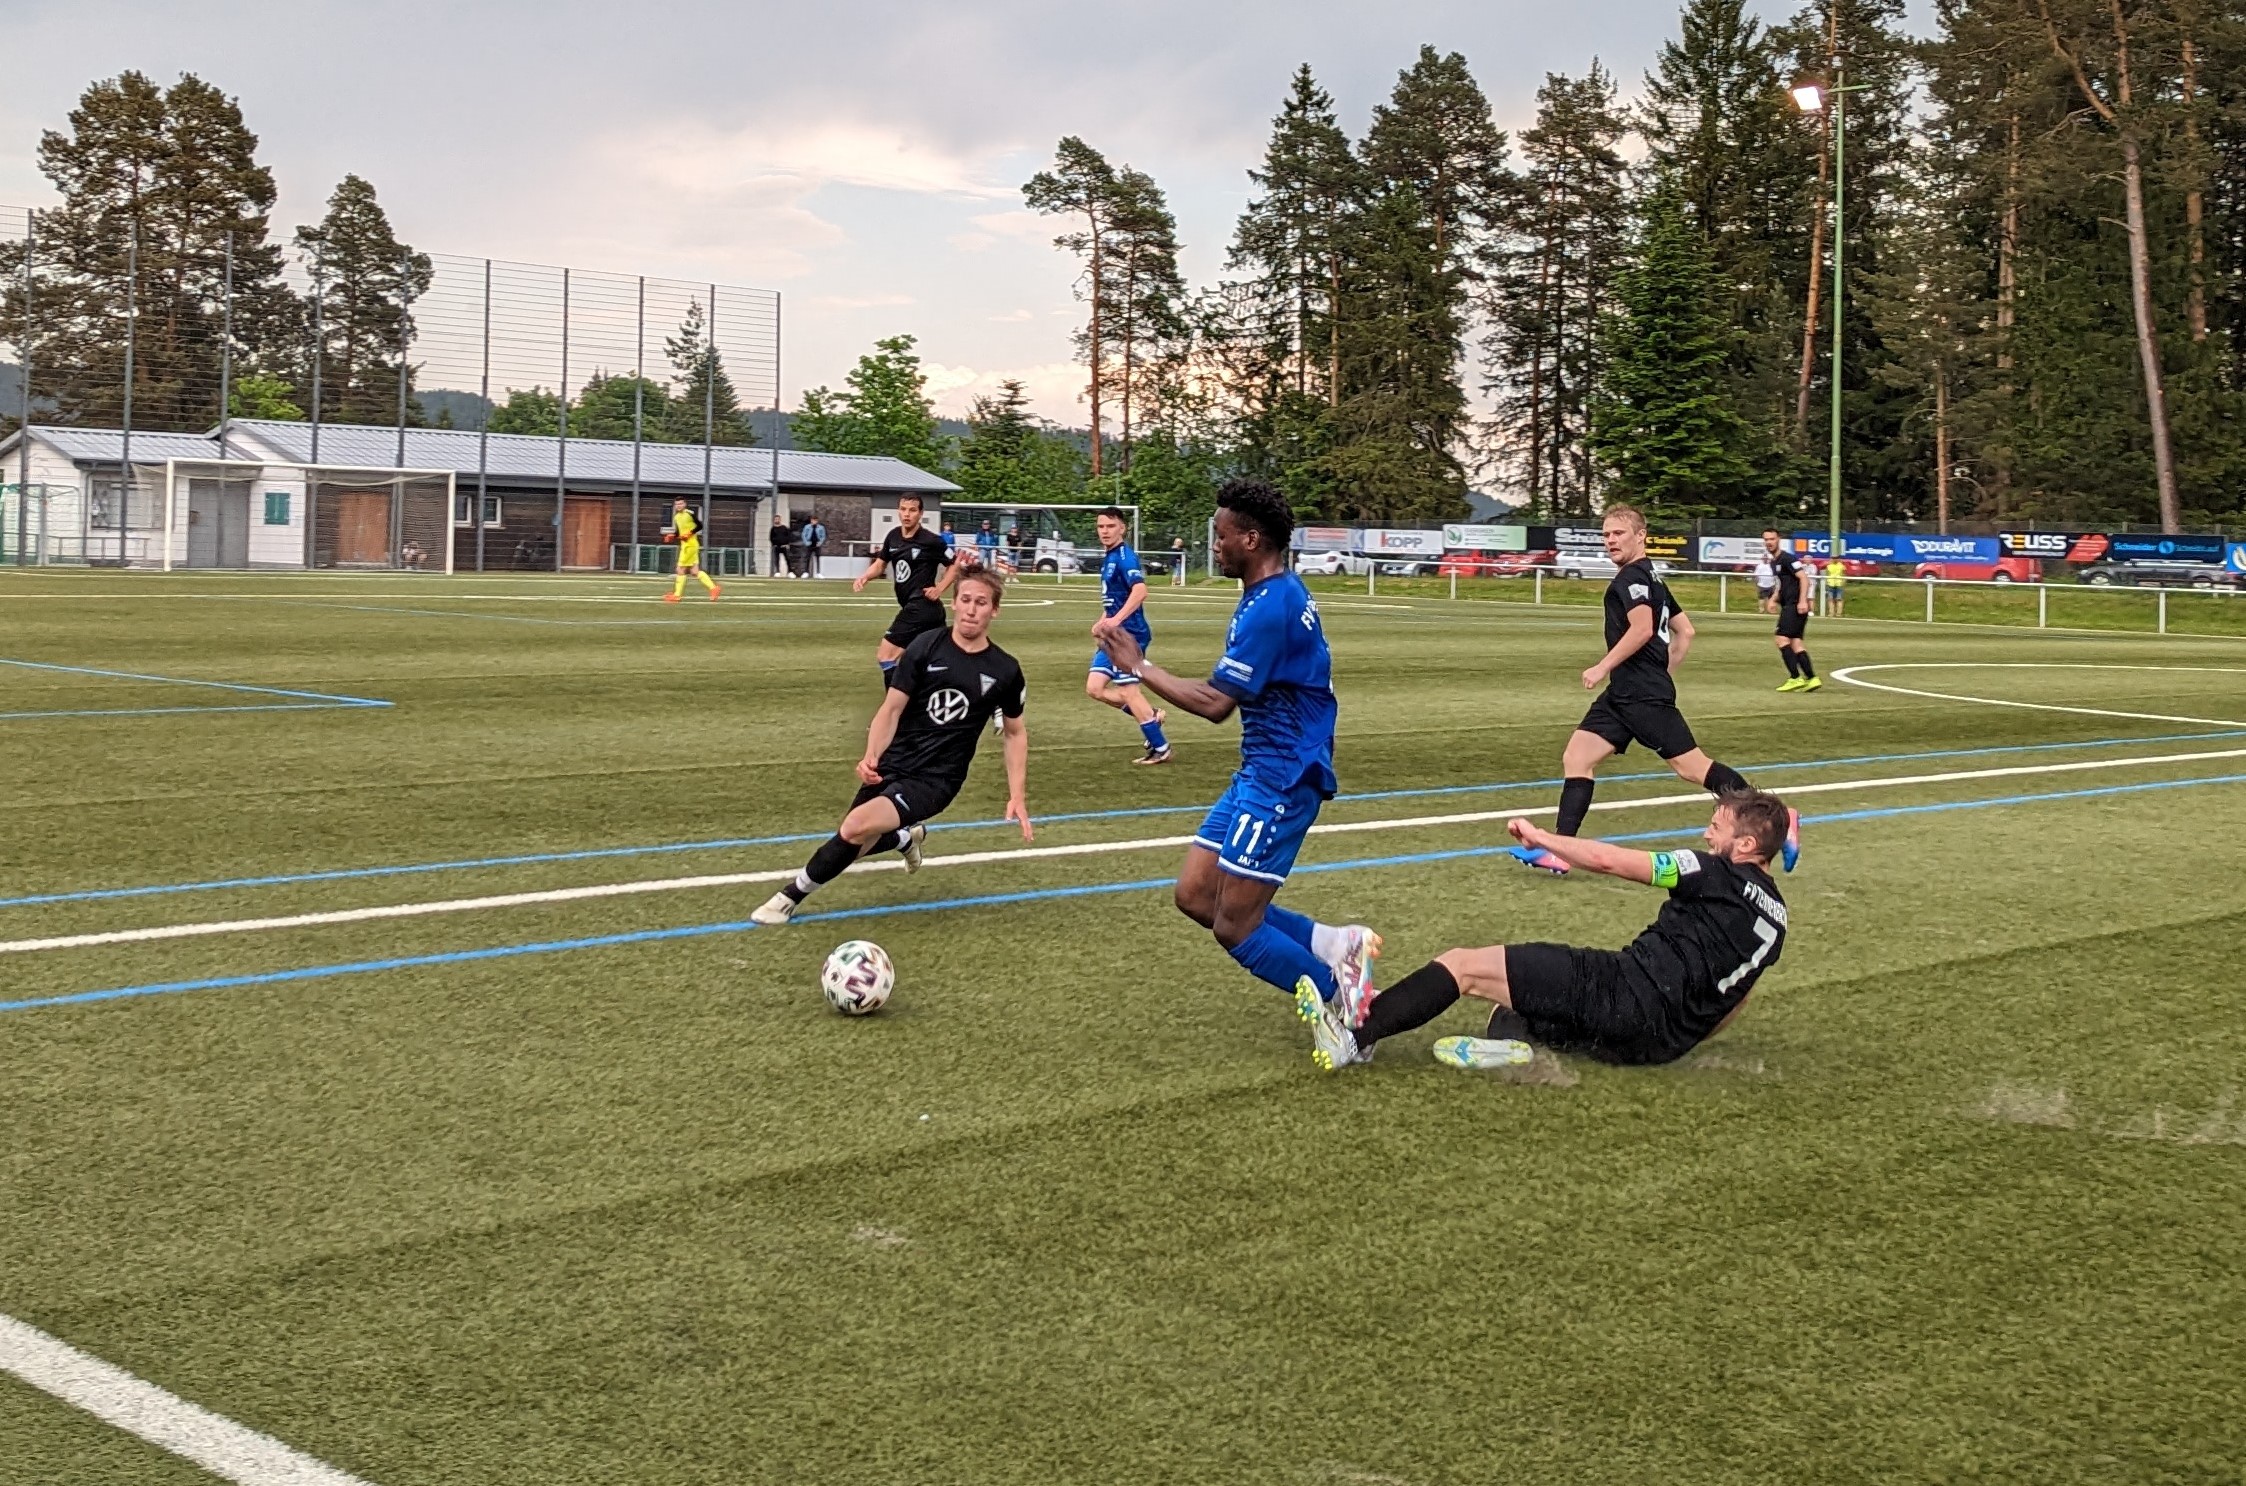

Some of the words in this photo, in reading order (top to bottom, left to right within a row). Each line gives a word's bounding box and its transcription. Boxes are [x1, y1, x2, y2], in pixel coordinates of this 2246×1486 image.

[2000, 534, 2067, 550] REUSS
[1231, 813, 1264, 855] 11
[1717, 915, 1778, 995] 7
